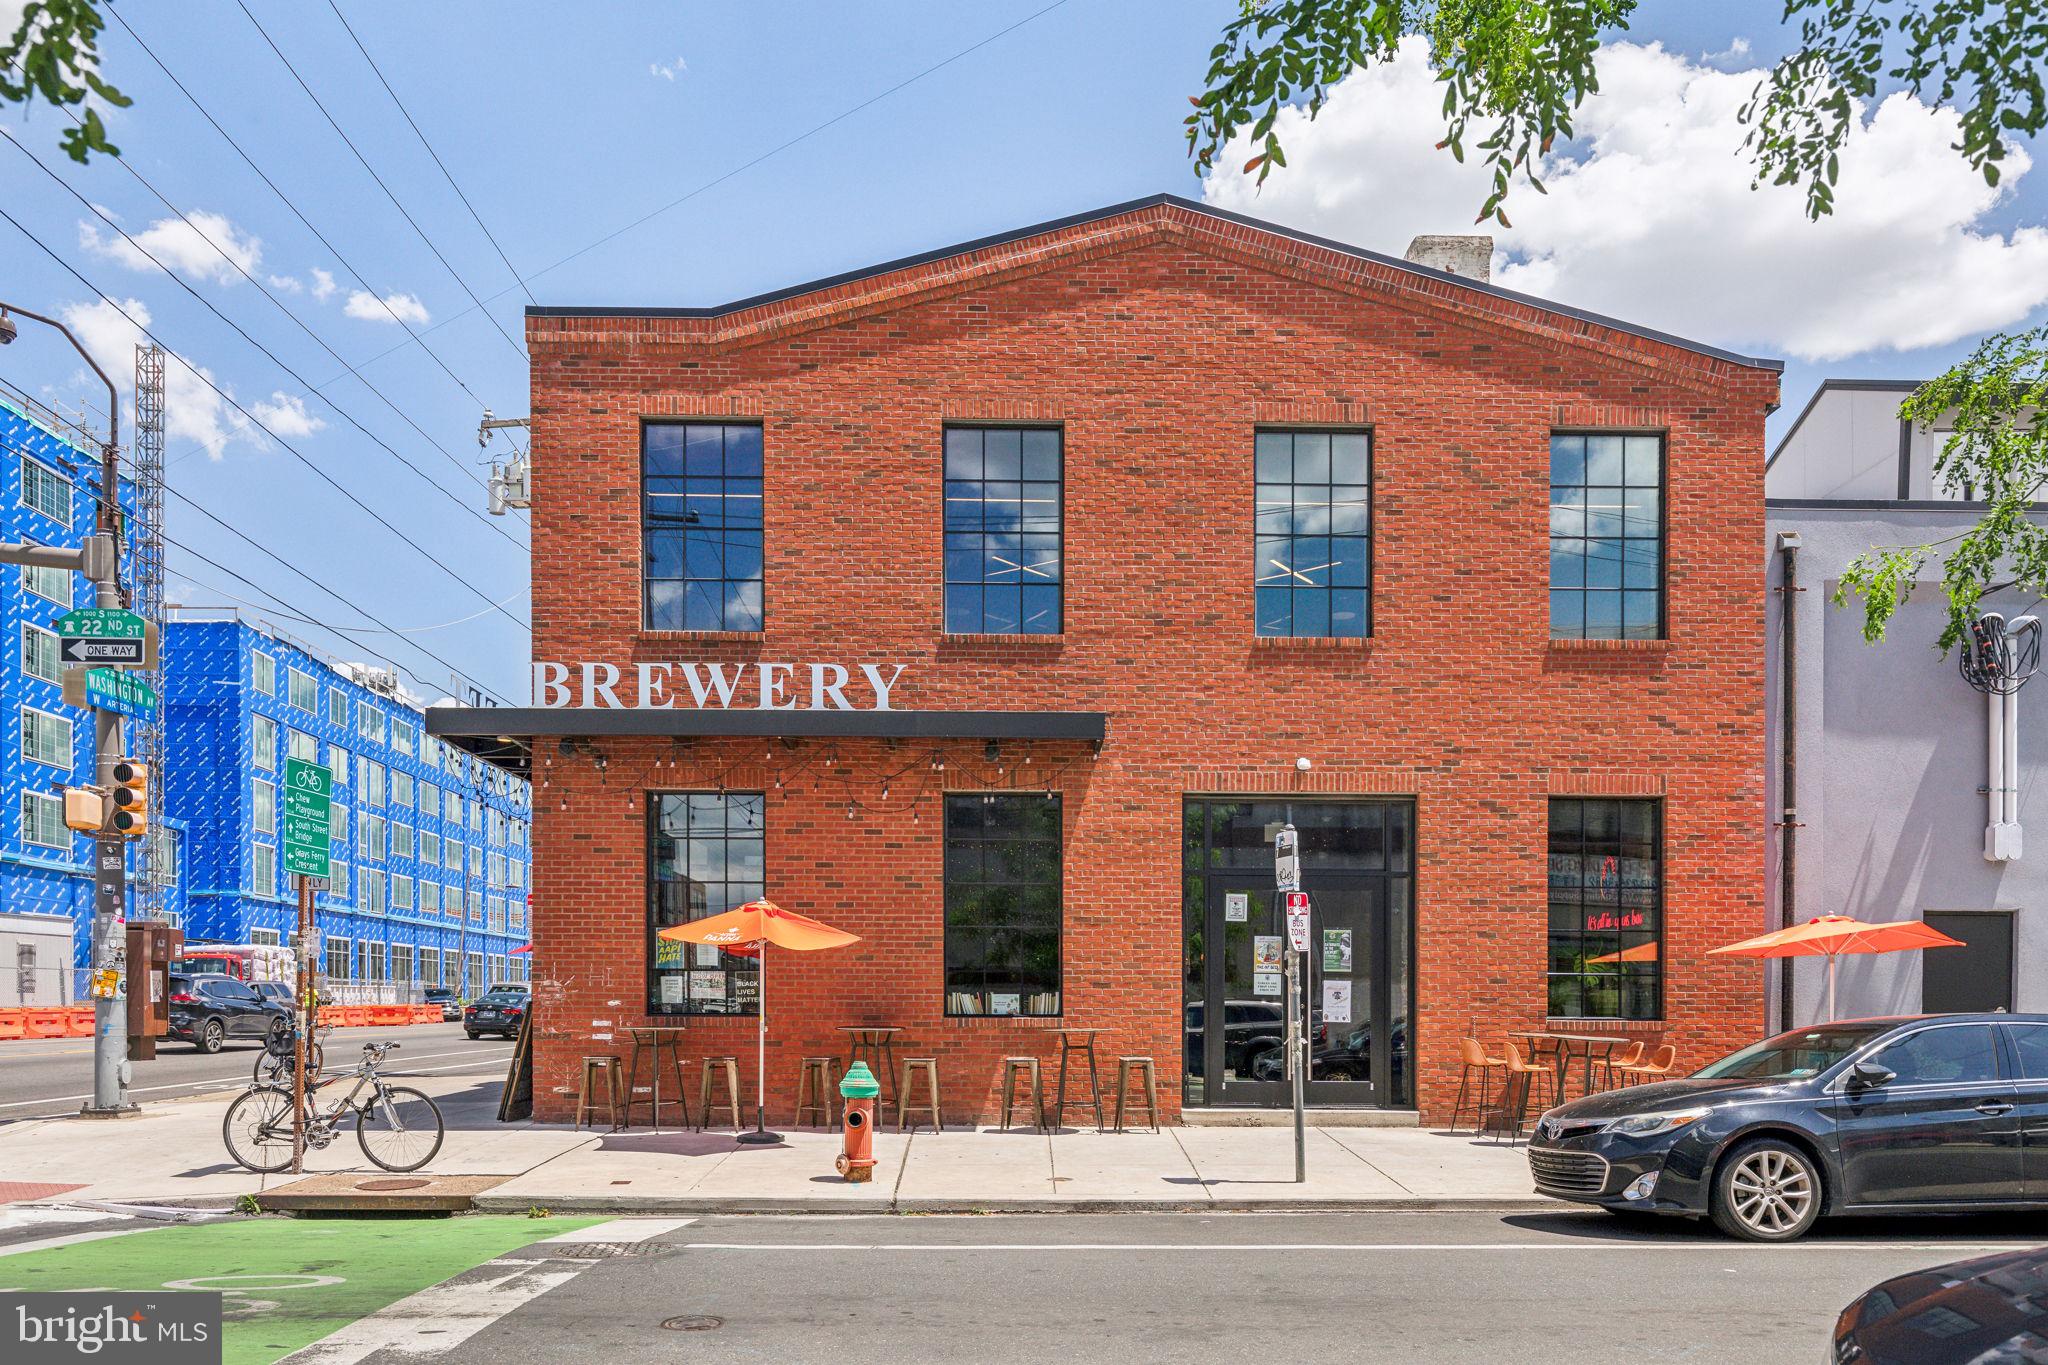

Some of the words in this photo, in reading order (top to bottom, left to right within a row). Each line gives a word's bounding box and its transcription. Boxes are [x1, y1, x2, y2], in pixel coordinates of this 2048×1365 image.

[99, 610, 105, 618] S
[81, 620, 102, 635] 22
[107, 620, 123, 631] ND
[126, 625, 140, 636] ST
[87, 645, 108, 656] ONE
[111, 646, 133, 656] WAY
[88, 671, 143, 704] WASHINGTON
[531, 662, 907, 710] BREWERY
[93, 693, 100, 704] W
[106, 699, 138, 715] ARERIA
[145, 709, 151, 720] E
[295, 792, 310, 804] Chew
[295, 803, 325, 819] Playground
[295, 820, 311, 832] South
[312, 824, 328, 836] Street
[295, 831, 313, 844] Bridge
[311, 852, 325, 864] Ferry
[294, 859, 319, 871] Crescent
[308, 877, 323, 888] NLY
[1293, 894, 1302, 906] NO
[1292, 920, 1304, 928] BUS
[1291, 928, 1306, 937] ZONE
[659, 942, 682, 954] AAPI
[658, 953, 682, 964] HATE
